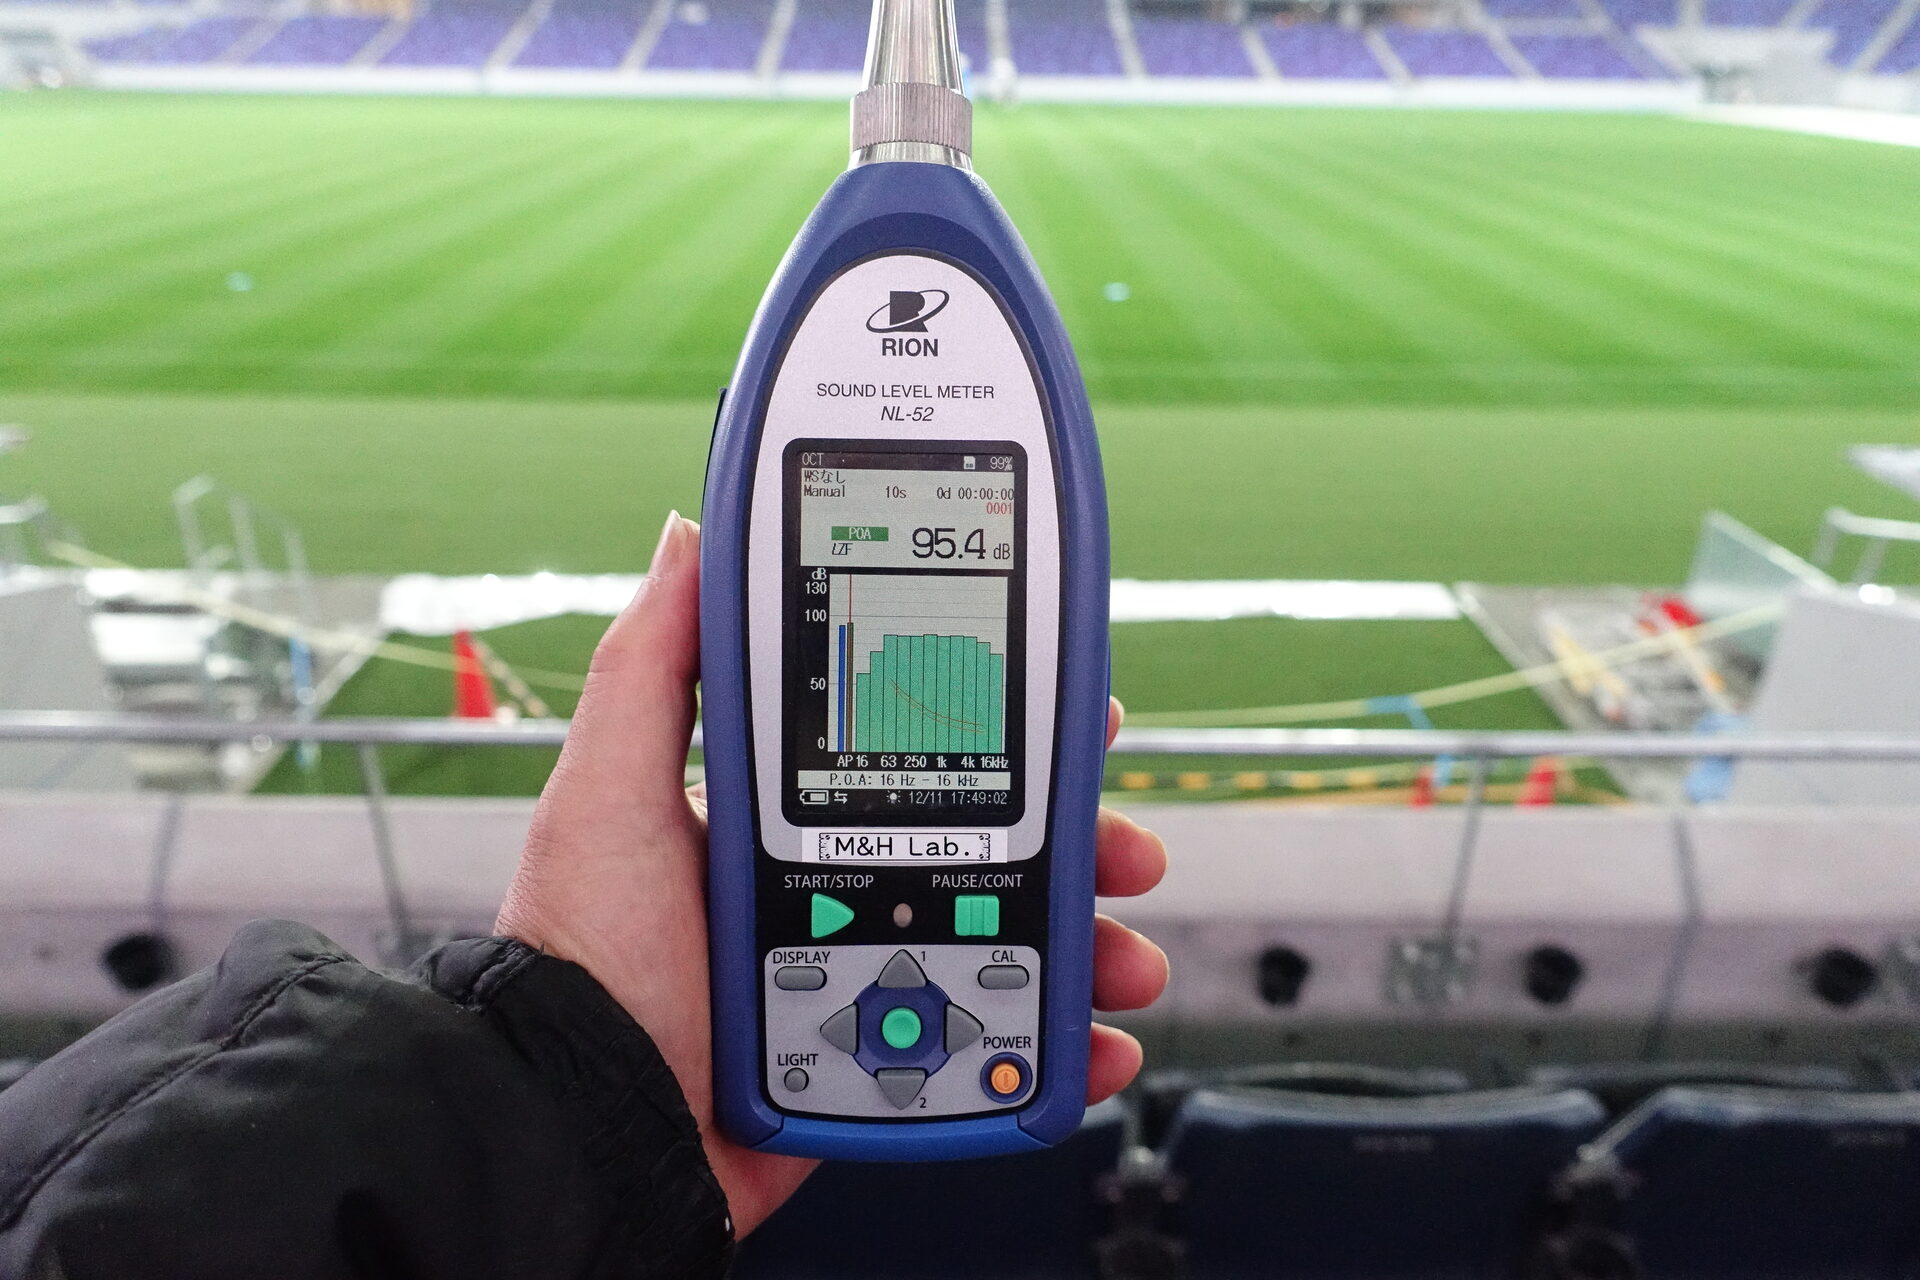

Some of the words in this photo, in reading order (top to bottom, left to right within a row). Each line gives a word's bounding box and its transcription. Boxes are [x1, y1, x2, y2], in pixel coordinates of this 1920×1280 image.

[881, 338, 939, 357] RION
[816, 383, 876, 398] SOUND
[881, 384, 932, 399] LEVEL
[937, 385, 995, 399] METER
[880, 406, 934, 422] NL-52
[801, 452, 825, 466] OCT
[989, 456, 1013, 471] 99%
[803, 484, 846, 498] Manual
[886, 486, 907, 499] 10s
[936, 487, 951, 499] 0d
[958, 487, 1014, 501] 00:00:00
[986, 502, 1013, 515] 0001
[848, 526, 872, 540] POA
[911, 527, 987, 560] 95.4
[993, 543, 1011, 560] dB
[811, 567, 827, 580] dB
[805, 582, 827, 595] 130
[804, 609, 827, 622] 100
[810, 678, 826, 690] 50
[817, 737, 825, 750] 0
[837, 754, 853, 768] AP
[856, 755, 868, 768] 16
[880, 755, 897, 768] 63
[904, 755, 927, 768] 250
[936, 755, 947, 768] 1k
[960, 755, 975, 768] 4k
[980, 755, 1009, 769] 16kHz
[880, 773, 895, 786] 16
[900, 773, 916, 786] Hz
[937, 774, 951, 787] 16
[957, 774, 979, 787] kHz
[908, 791, 943, 805] 12/11
[951, 791, 1008, 805] 17:49:02
[834, 836, 893, 857] M&H
[908, 836, 971, 857] Lab.
[783, 874, 875, 889] START/STOP
[931, 873, 1024, 889] PAUSE/CONT
[772, 951, 831, 964] DISPLAY
[920, 951, 926, 962] 1
[991, 950, 1017, 963] CAL
[983, 1036, 1032, 1050] POWER
[777, 1053, 819, 1067] LIGHT
[919, 1098, 927, 1109] 2
